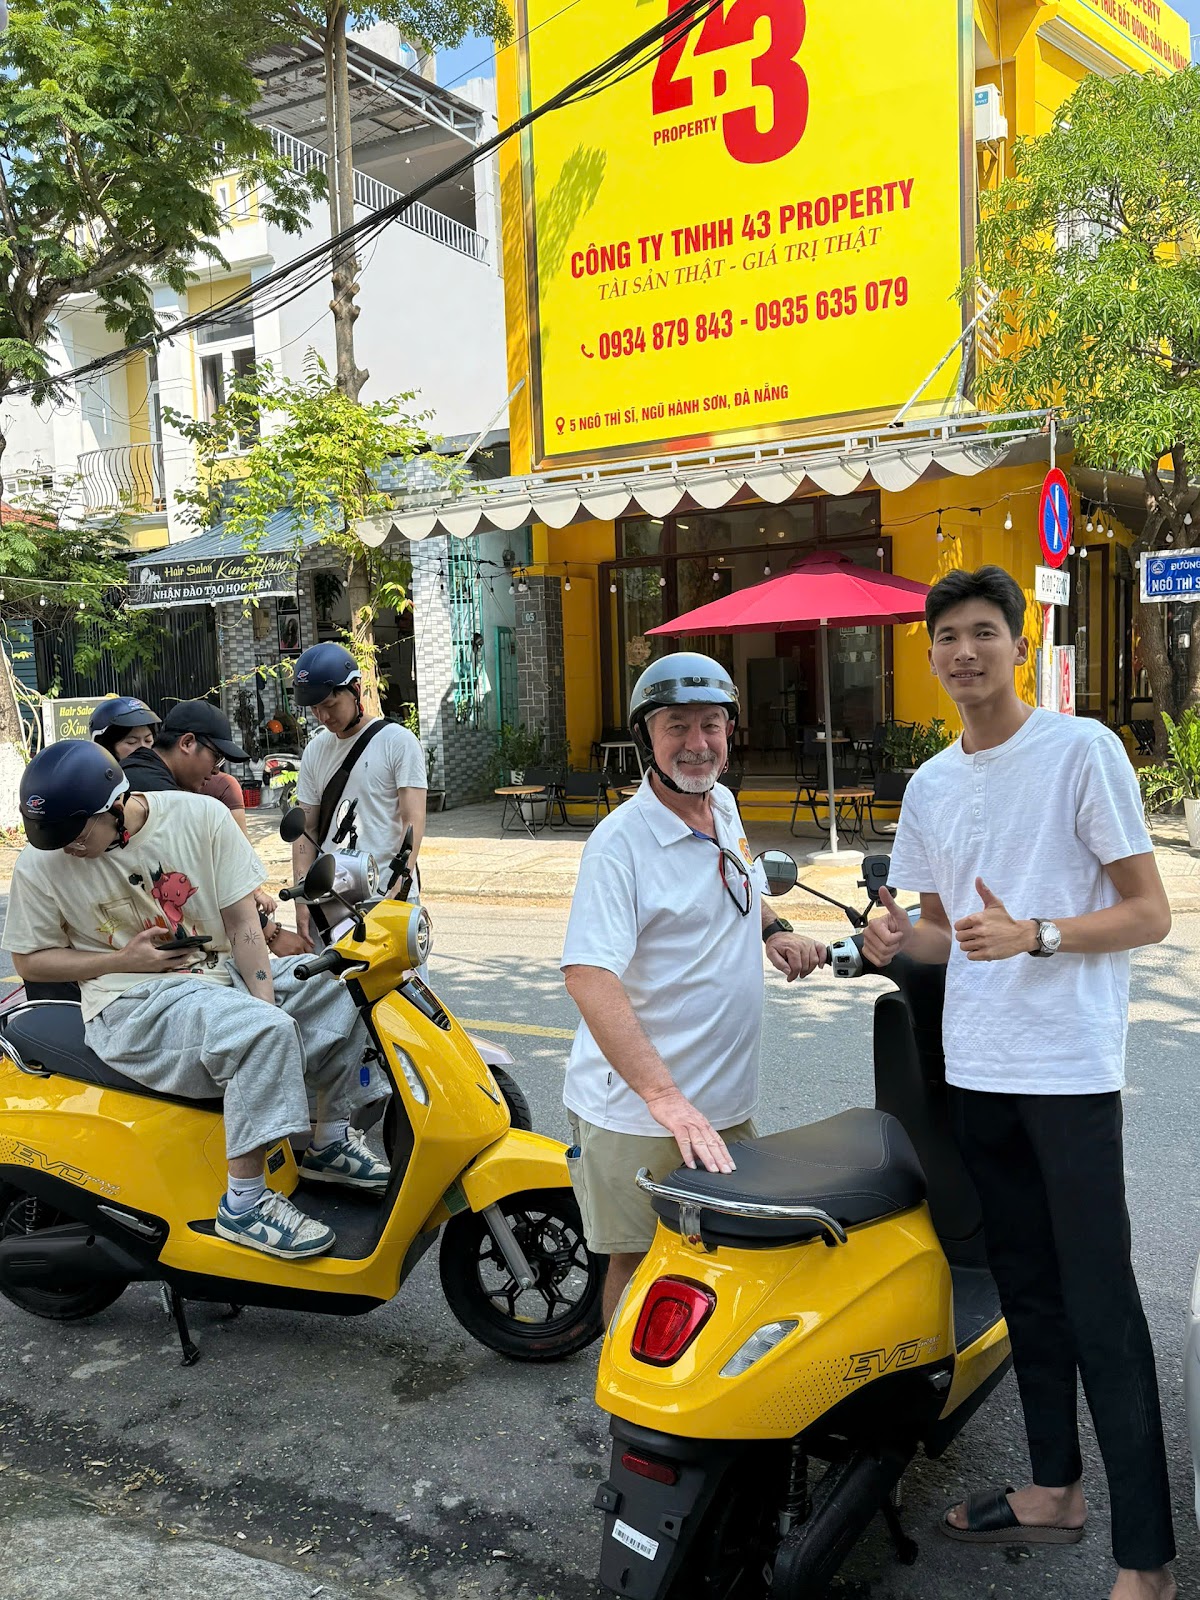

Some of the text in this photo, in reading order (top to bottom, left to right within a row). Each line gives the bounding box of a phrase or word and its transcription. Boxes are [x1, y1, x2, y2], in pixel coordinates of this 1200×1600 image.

[1118, 3, 1131, 31] BẤT
[1131, 14, 1150, 47] ĐỘNG
[1150, 27, 1163, 57] SẢN
[1163, 40, 1173, 64] ĐÀ
[653, 115, 717, 146] PROPERTY
[571, 178, 915, 279] CÔNG TY TNHH 43 PROPERTY
[598, 277, 629, 301] TÀI
[632, 268, 669, 294] SẢN
[674, 258, 725, 286] THẬT
[742, 243, 778, 271] GIÁ
[784, 239, 819, 262] TRỊ
[824, 225, 882, 255] THẬT
[599, 276, 908, 360] 0934 879 843 - 0935 635 079
[570, 383, 789, 432] 5 NGÔ THÌ SĨ, NGŨ HÀNH SƠN, ĐÀ NẴNG
[164, 565, 185, 578] Hair
[1152, 576, 1173, 592] NGÔ
[1176, 574, 1193, 590] THÌ
[1170, 560, 1200, 571] ĐƯỜNG
[153, 587, 181, 600] NHẬN
[182, 585, 203, 597] ĐÀO
[204, 584, 224, 598] TẠO
[248, 578, 273, 592] IÊN
[59, 705, 96, 717] Hair Salo
[60, 718, 87, 737] Kim
[11, 1141, 88, 1186] EVO
[843, 1337, 922, 1381] EVO
